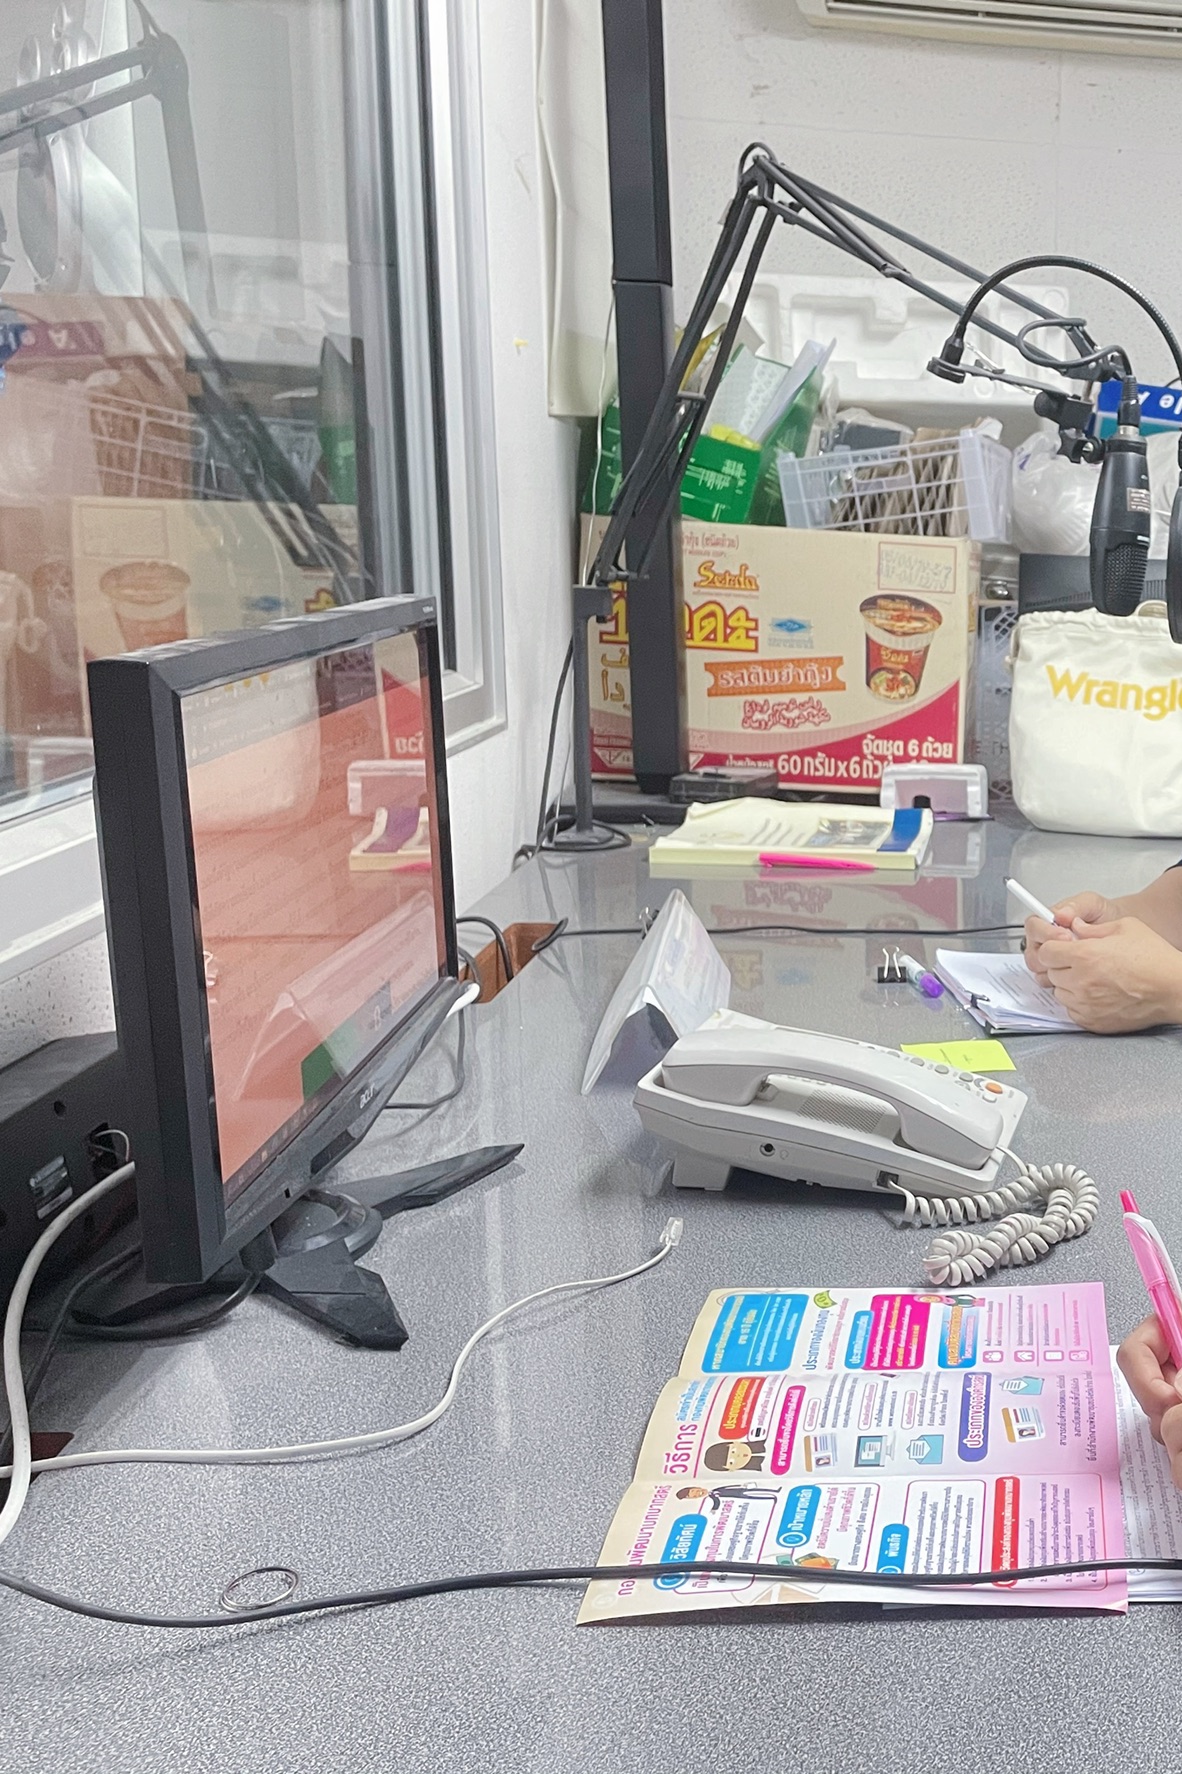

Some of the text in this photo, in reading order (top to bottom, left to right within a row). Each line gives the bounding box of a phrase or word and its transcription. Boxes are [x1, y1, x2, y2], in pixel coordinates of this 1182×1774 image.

[908, 739, 919, 757] 6
[664, 1425, 697, 1473] วิธีการ
[670, 1524, 696, 1559] วิสัยทัศน์
[885, 1534, 901, 1556] พันธกิจ
